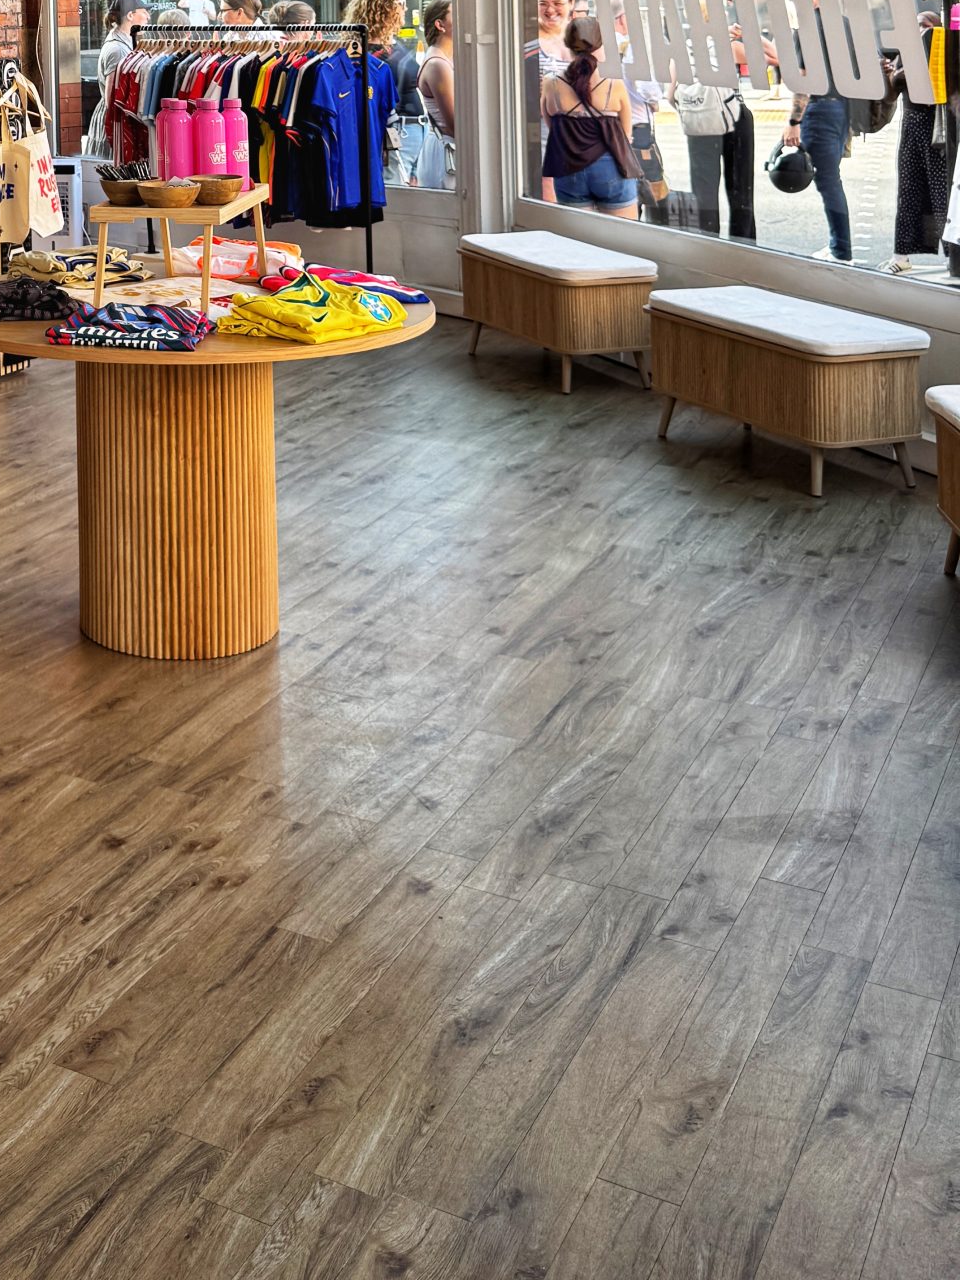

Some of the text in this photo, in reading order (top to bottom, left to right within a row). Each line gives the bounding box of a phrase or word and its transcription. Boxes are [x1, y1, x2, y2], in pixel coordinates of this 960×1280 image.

[210, 152, 226, 164] WS
[234, 150, 248, 161] WS
[38, 177, 56, 198] RUS
[60, 326, 180, 340] mirtes
